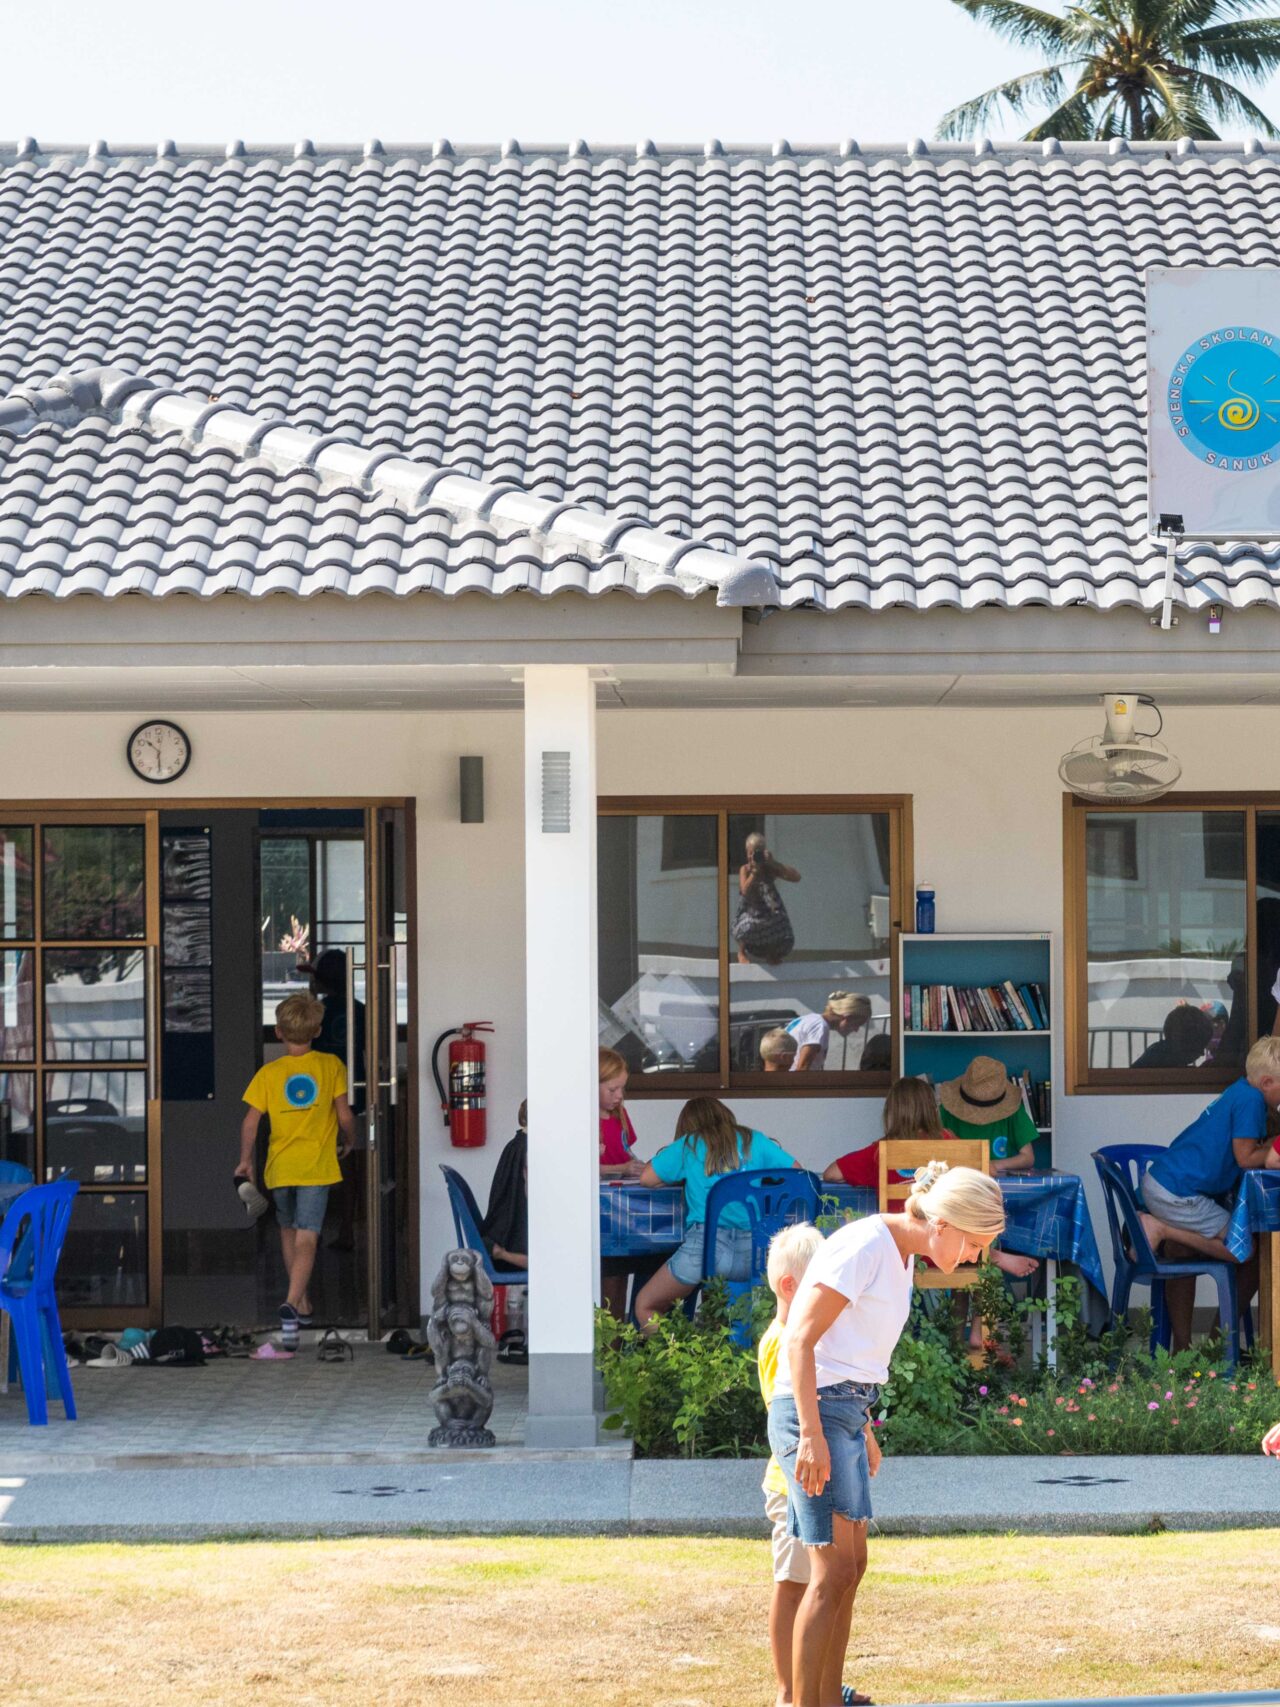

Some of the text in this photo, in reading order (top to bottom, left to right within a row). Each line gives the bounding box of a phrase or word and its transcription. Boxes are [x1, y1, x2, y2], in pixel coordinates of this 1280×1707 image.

[1170, 353, 1196, 437] SVENSKA
[1200, 329, 1273, 350] SKOLAN
[1206, 452, 1273, 471] SANUK
